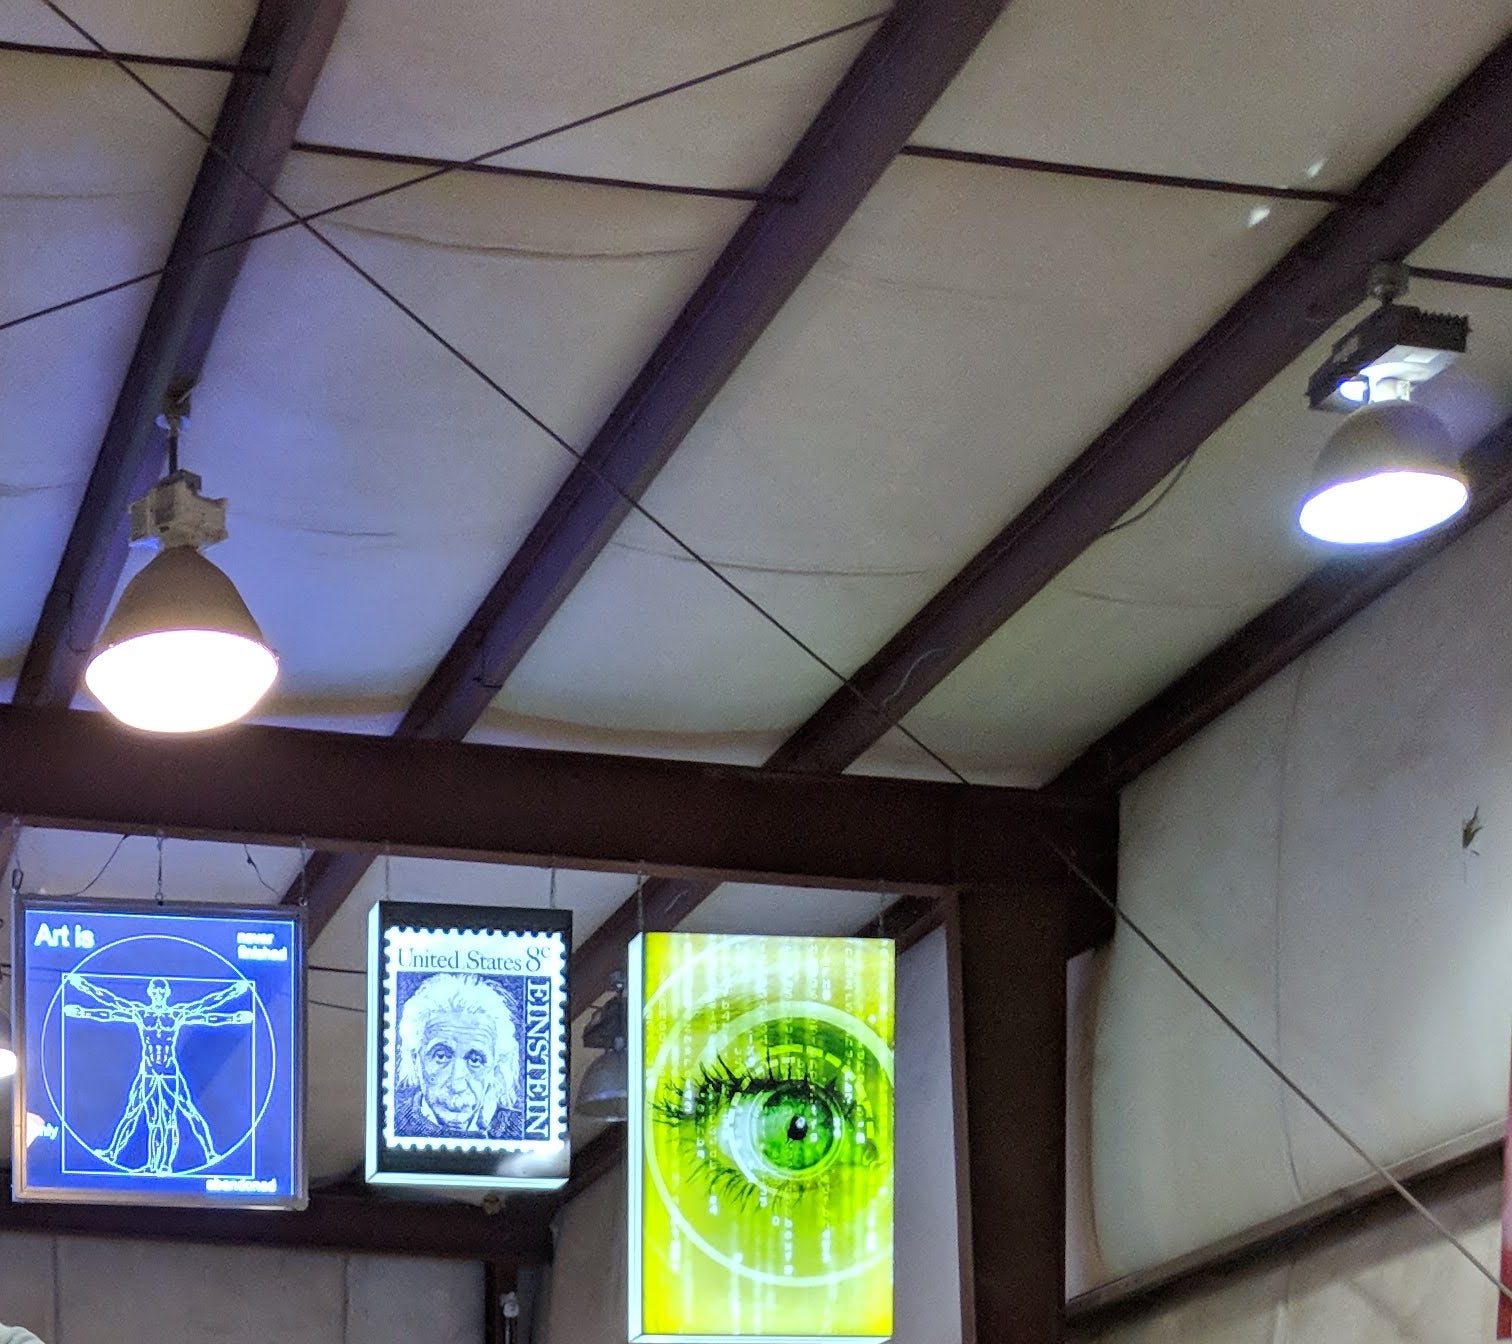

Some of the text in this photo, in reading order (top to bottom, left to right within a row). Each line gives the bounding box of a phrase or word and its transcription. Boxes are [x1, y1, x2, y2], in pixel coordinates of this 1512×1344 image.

[34, 922, 96, 949] Art is
[237, 932, 275, 945] never
[397, 947, 460, 969] United
[465, 949, 522, 971] States
[525, 976, 550, 1140] EINSTEIN
[206, 1177, 277, 1193] abandoned
